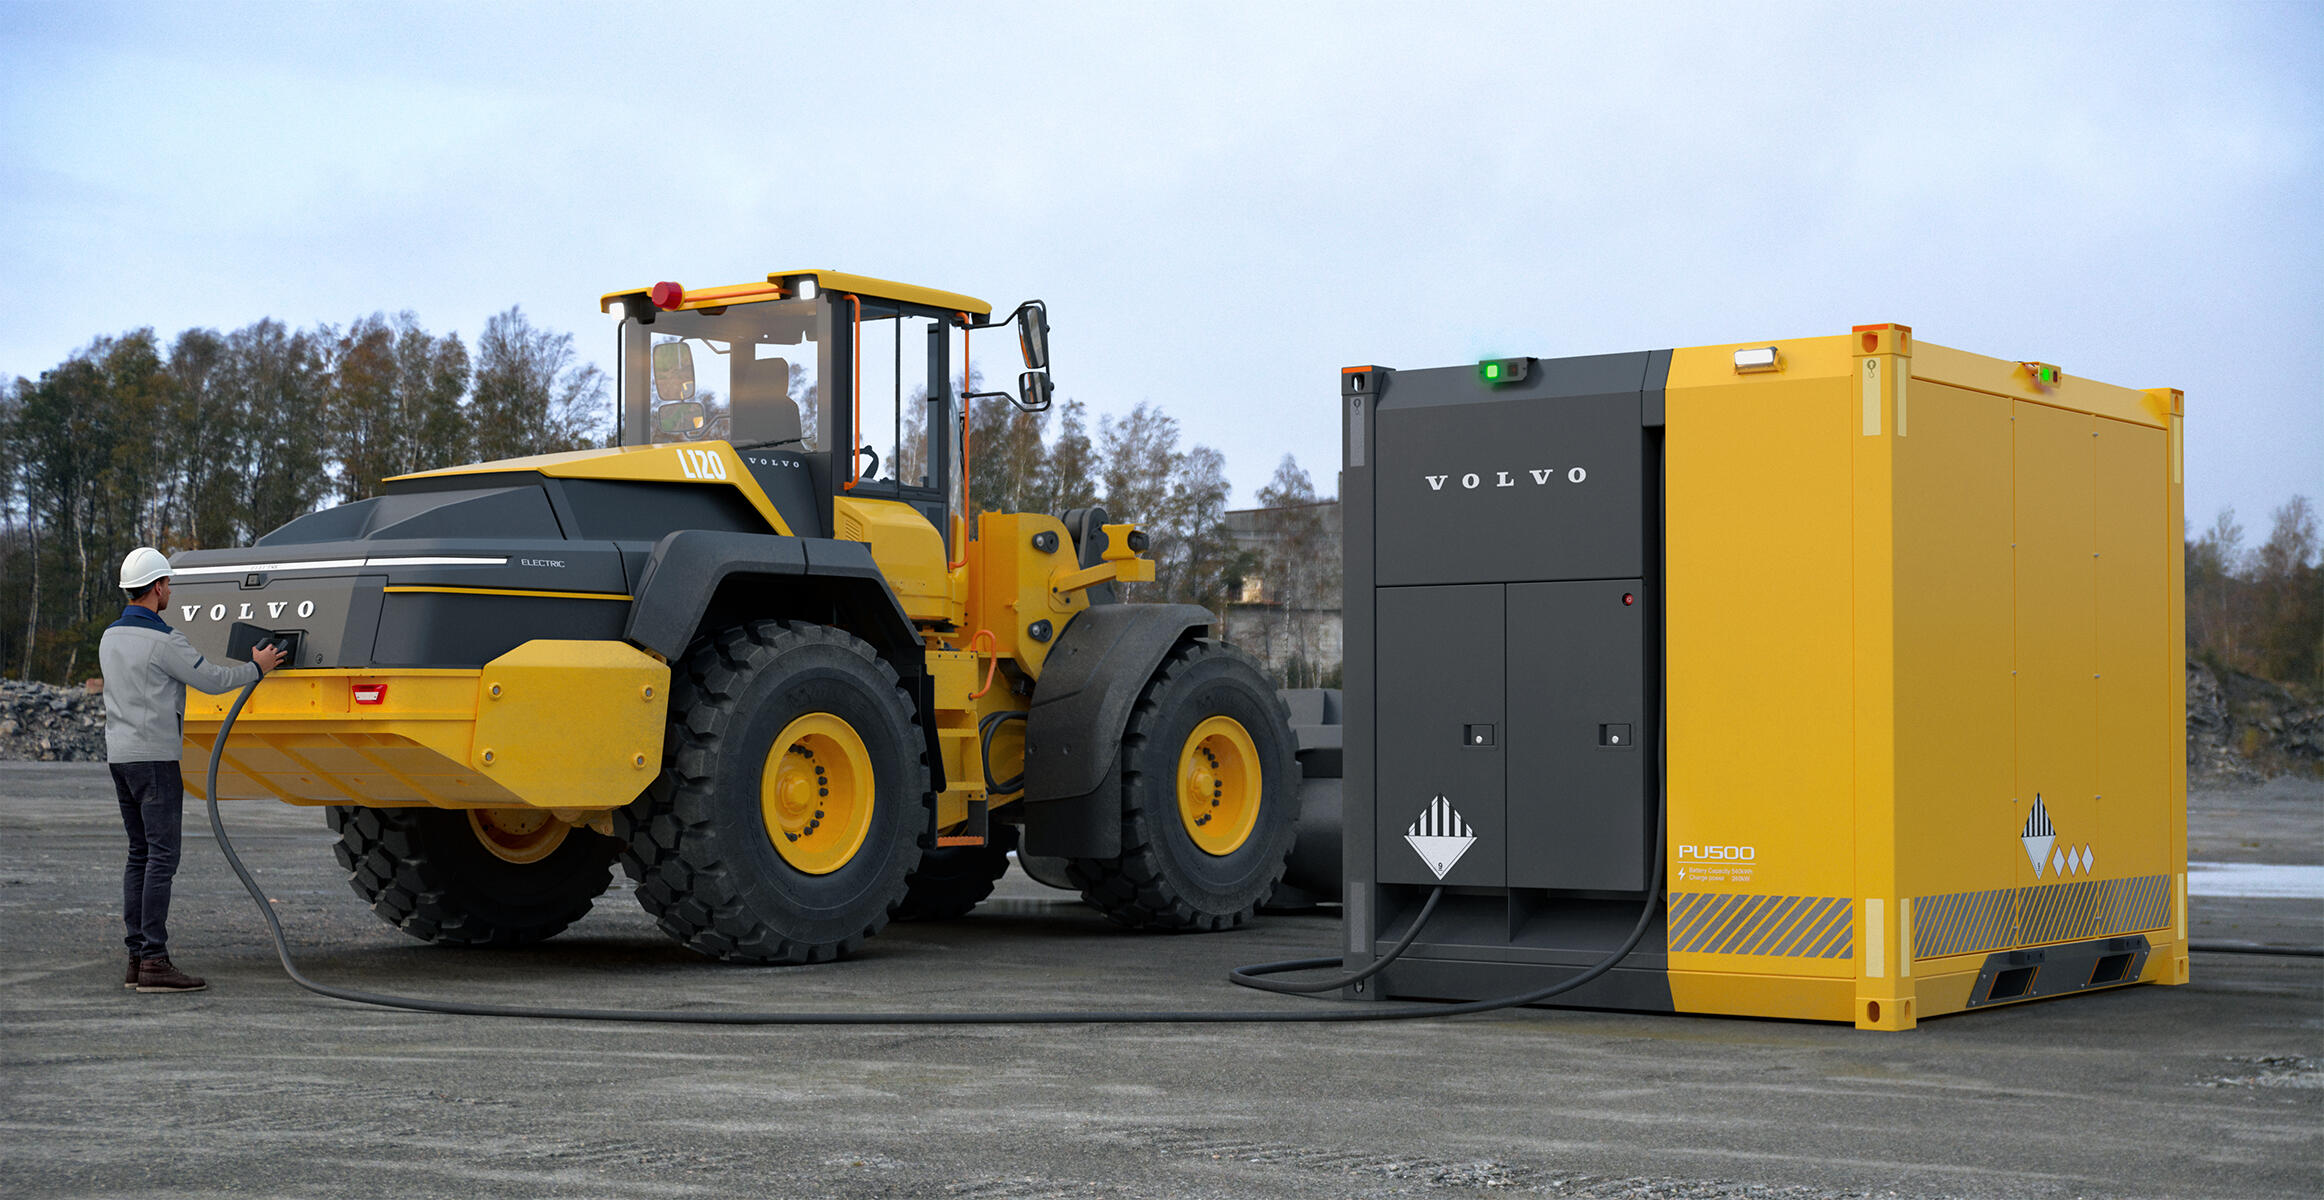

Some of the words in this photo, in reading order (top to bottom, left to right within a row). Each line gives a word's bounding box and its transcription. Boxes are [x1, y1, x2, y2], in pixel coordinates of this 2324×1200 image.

[676, 449, 727, 480] L120
[748, 457, 800, 468] VOLVO
[1425, 466, 1587, 491] VOLVO
[520, 558, 566, 568] ELECTRIC
[181, 600, 315, 622] VOLVO
[1679, 845, 1755, 860] PU500
